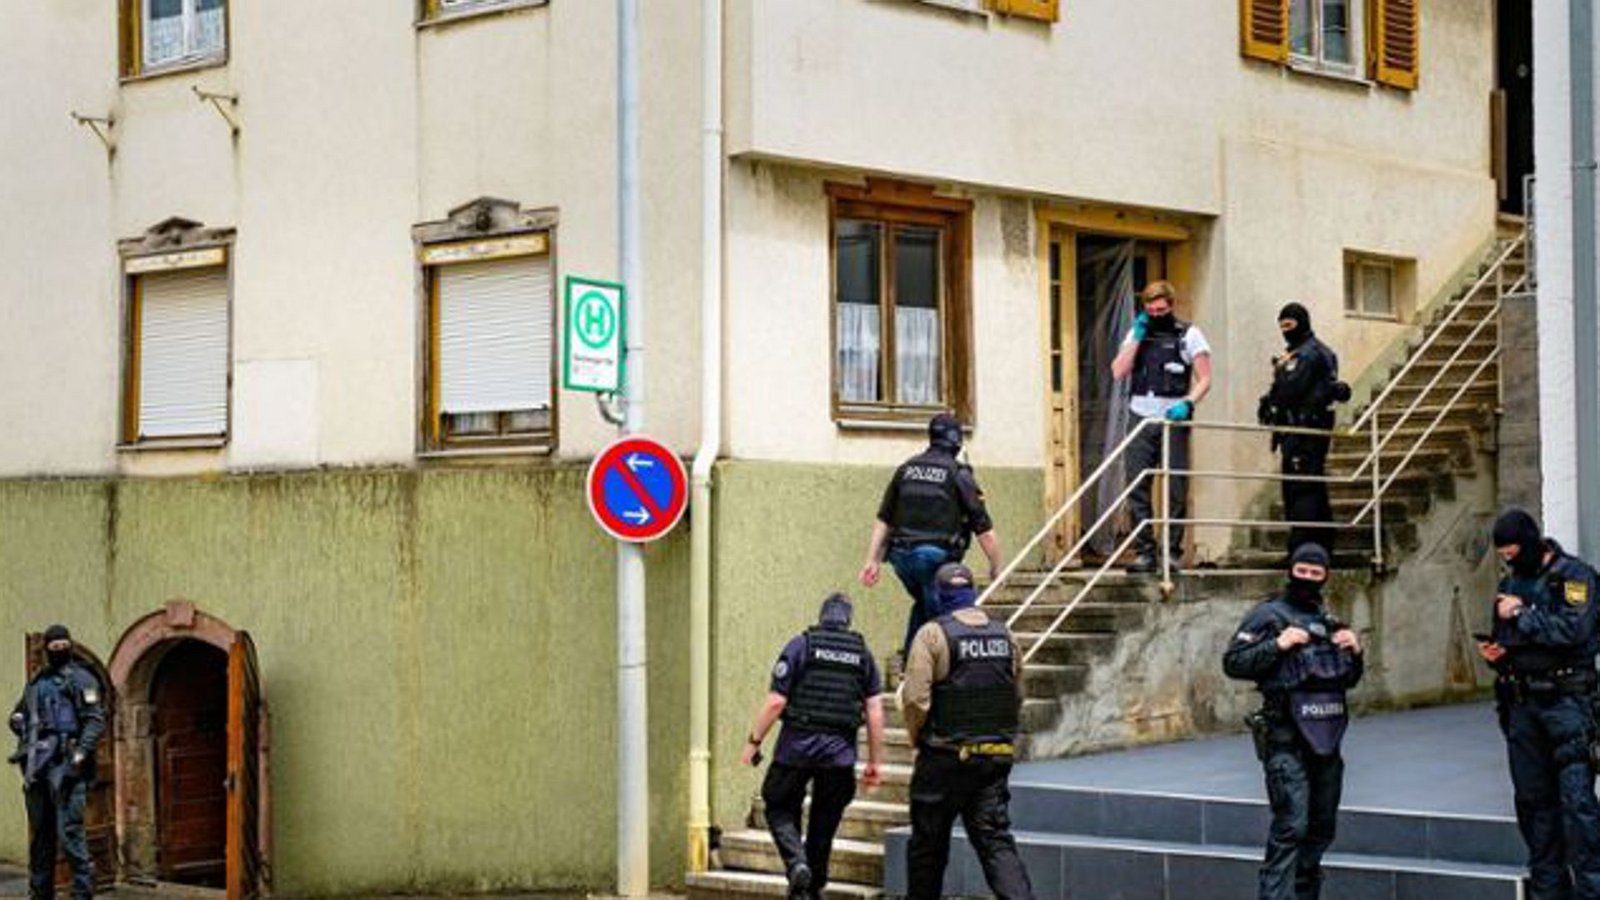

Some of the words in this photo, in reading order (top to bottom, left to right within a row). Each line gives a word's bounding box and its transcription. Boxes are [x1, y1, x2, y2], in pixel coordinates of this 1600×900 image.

[585, 302, 605, 337] H
[903, 465, 948, 482] POLIZEI
[815, 649, 860, 665] POLIZEI
[959, 639, 1008, 658] POLIZEI
